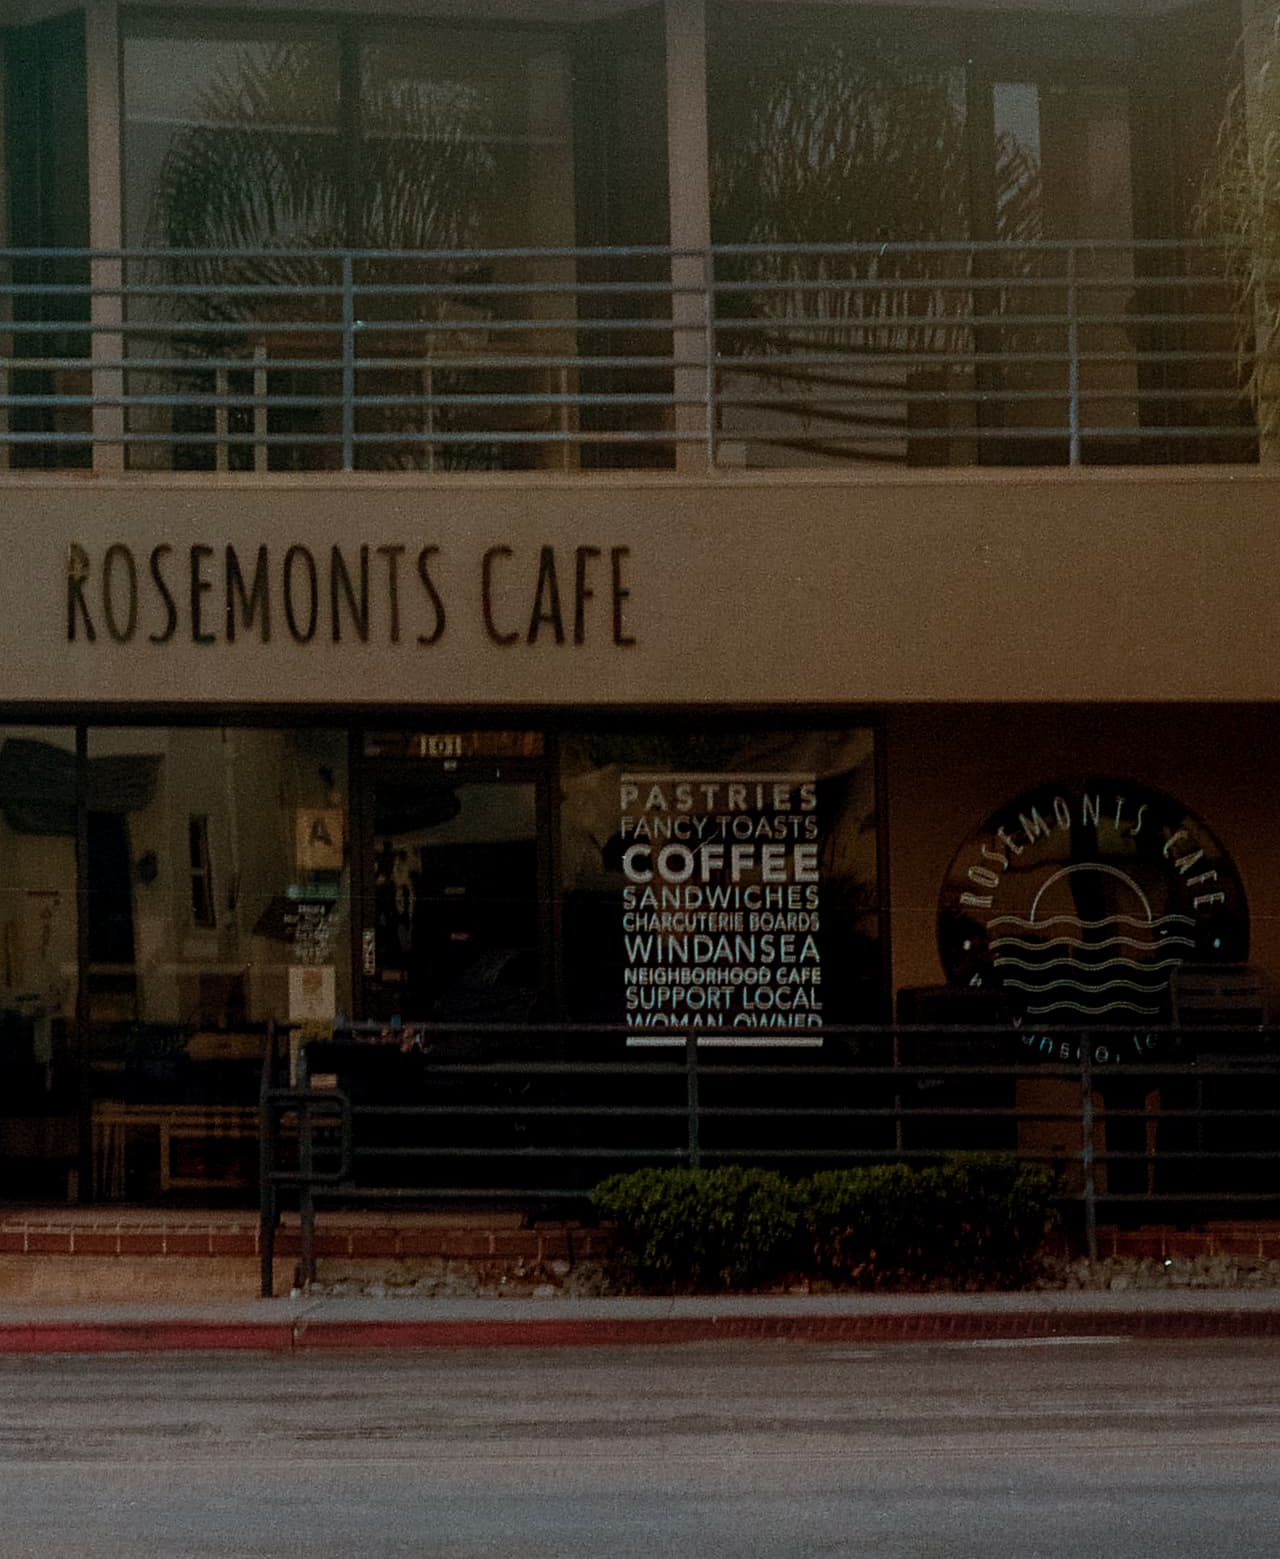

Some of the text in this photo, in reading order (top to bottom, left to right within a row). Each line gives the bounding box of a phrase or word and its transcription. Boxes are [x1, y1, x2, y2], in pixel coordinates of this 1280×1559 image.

[66, 543, 637, 645] ROSEMONTS CAFE
[620, 783, 817, 811] PASTRIES
[621, 816, 819, 840] FANCY TOASTS
[622, 843, 819, 883] COFFEE
[959, 794, 1226, 910] ROSEMONTS CAFE
[623, 885, 820, 910] SANDWICHES
[623, 912, 820, 932] CHARCUTERIE BOARDS
[625, 935, 820, 963] WINDANSEA
[624, 967, 822, 986] NEIGHBORHOOD CAFE
[626, 986, 823, 1010] SUPPORT LOCAL
[626, 1013, 823, 1028] WOMAN OWNED
